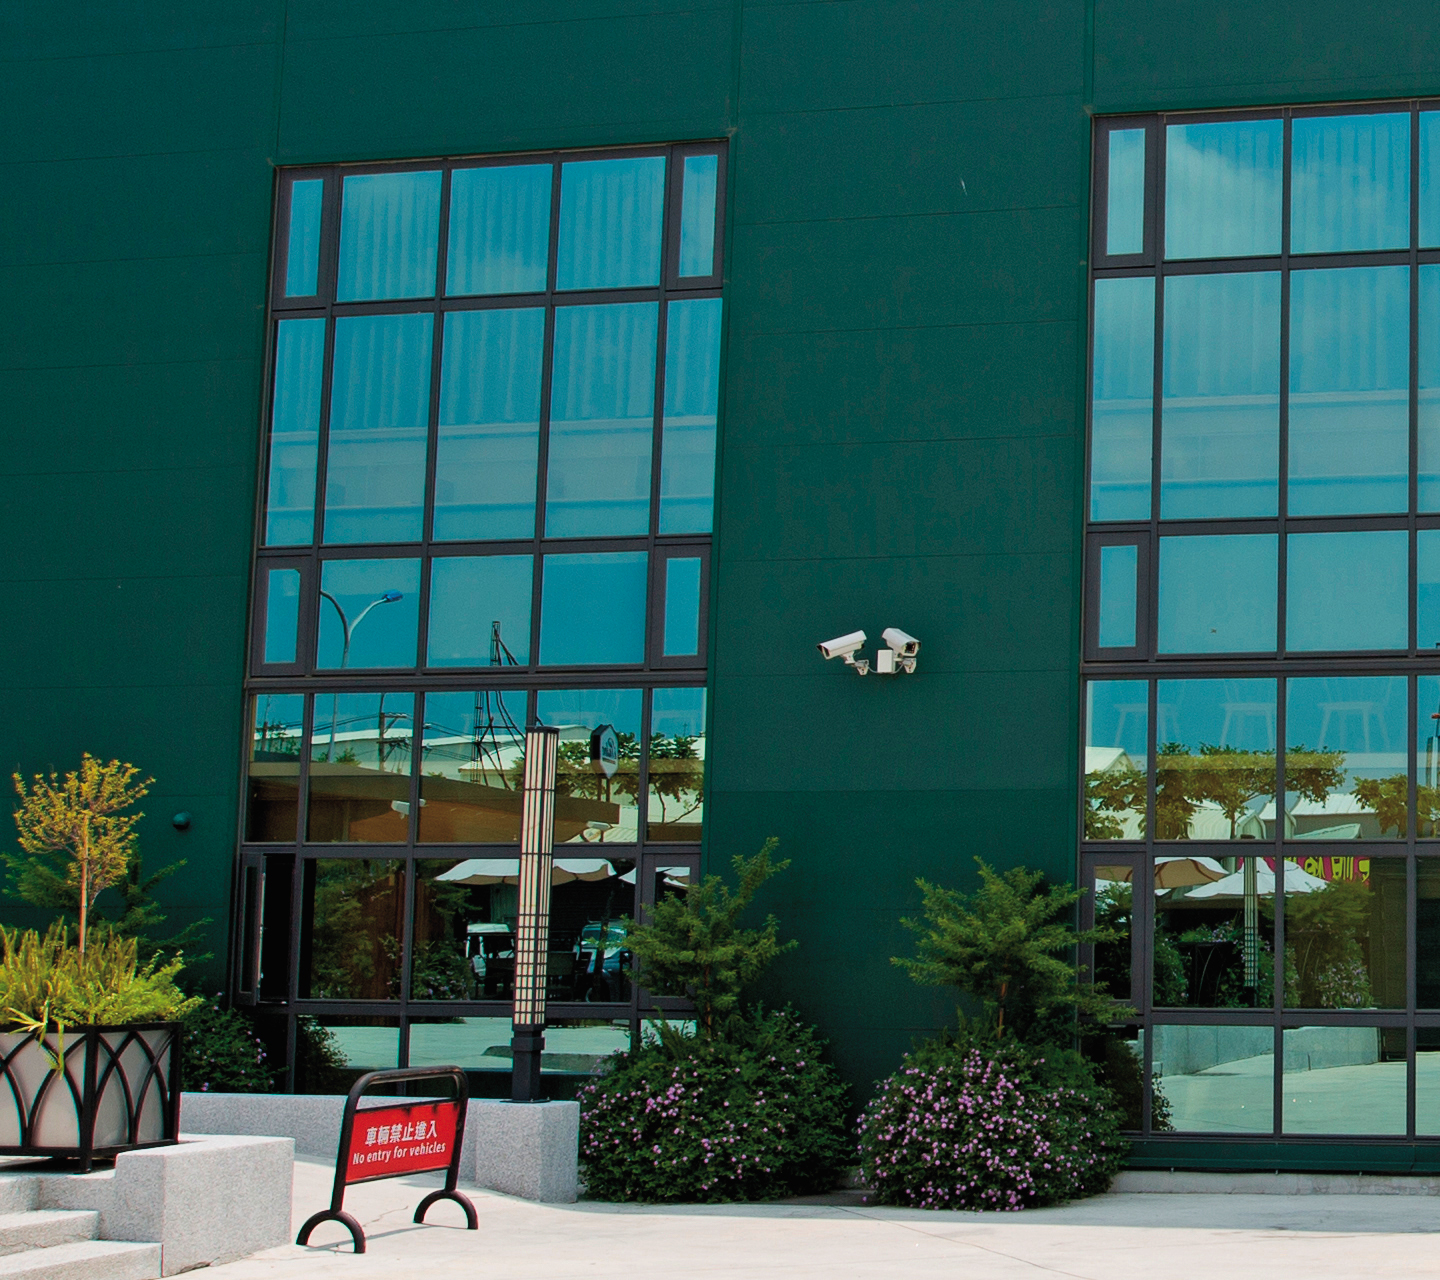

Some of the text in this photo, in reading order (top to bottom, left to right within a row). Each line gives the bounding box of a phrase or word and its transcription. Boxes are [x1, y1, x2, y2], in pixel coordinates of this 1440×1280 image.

[364, 1120, 438, 1146] 車輛禁止進入
[352, 1141, 446, 1165] No entry for vehicles
